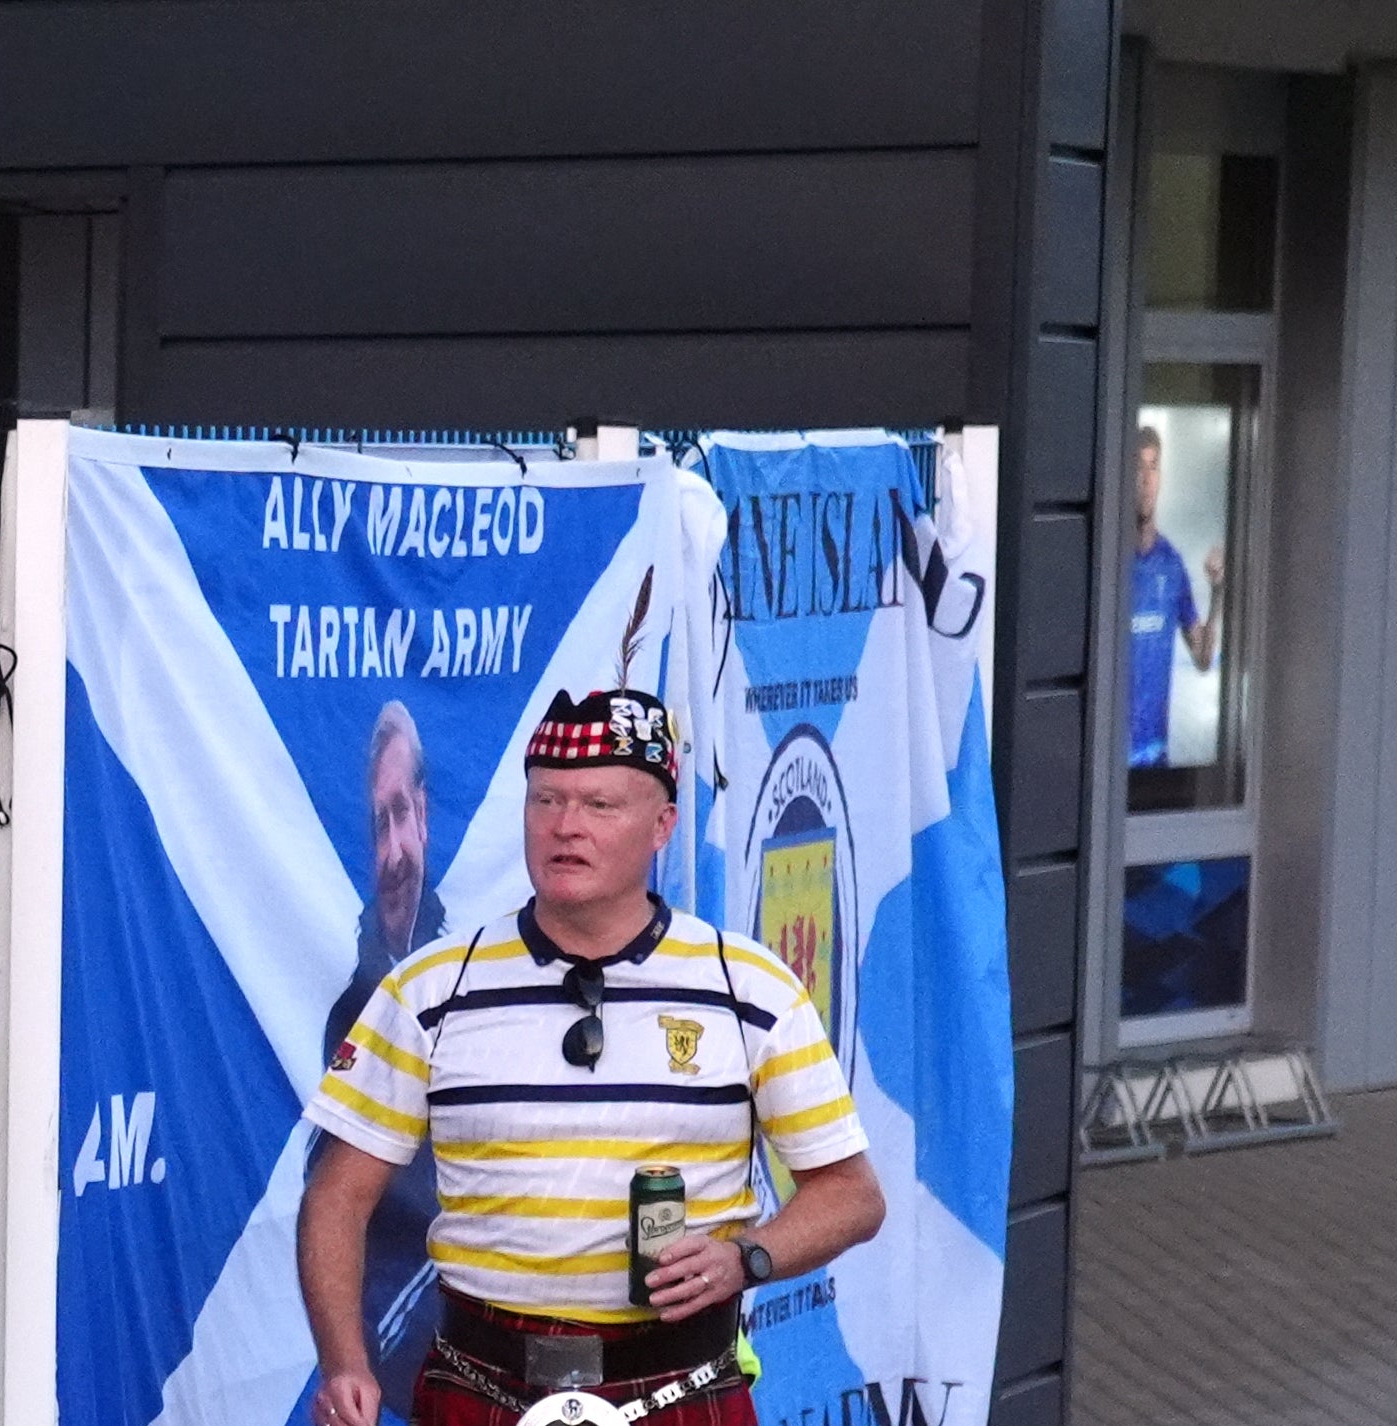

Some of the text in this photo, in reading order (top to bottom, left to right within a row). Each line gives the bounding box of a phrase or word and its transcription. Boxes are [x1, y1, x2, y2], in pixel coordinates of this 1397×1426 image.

[262, 475, 545, 558] ALLY MACLEOD
[269, 603, 533, 678] TARTAN ARMY
